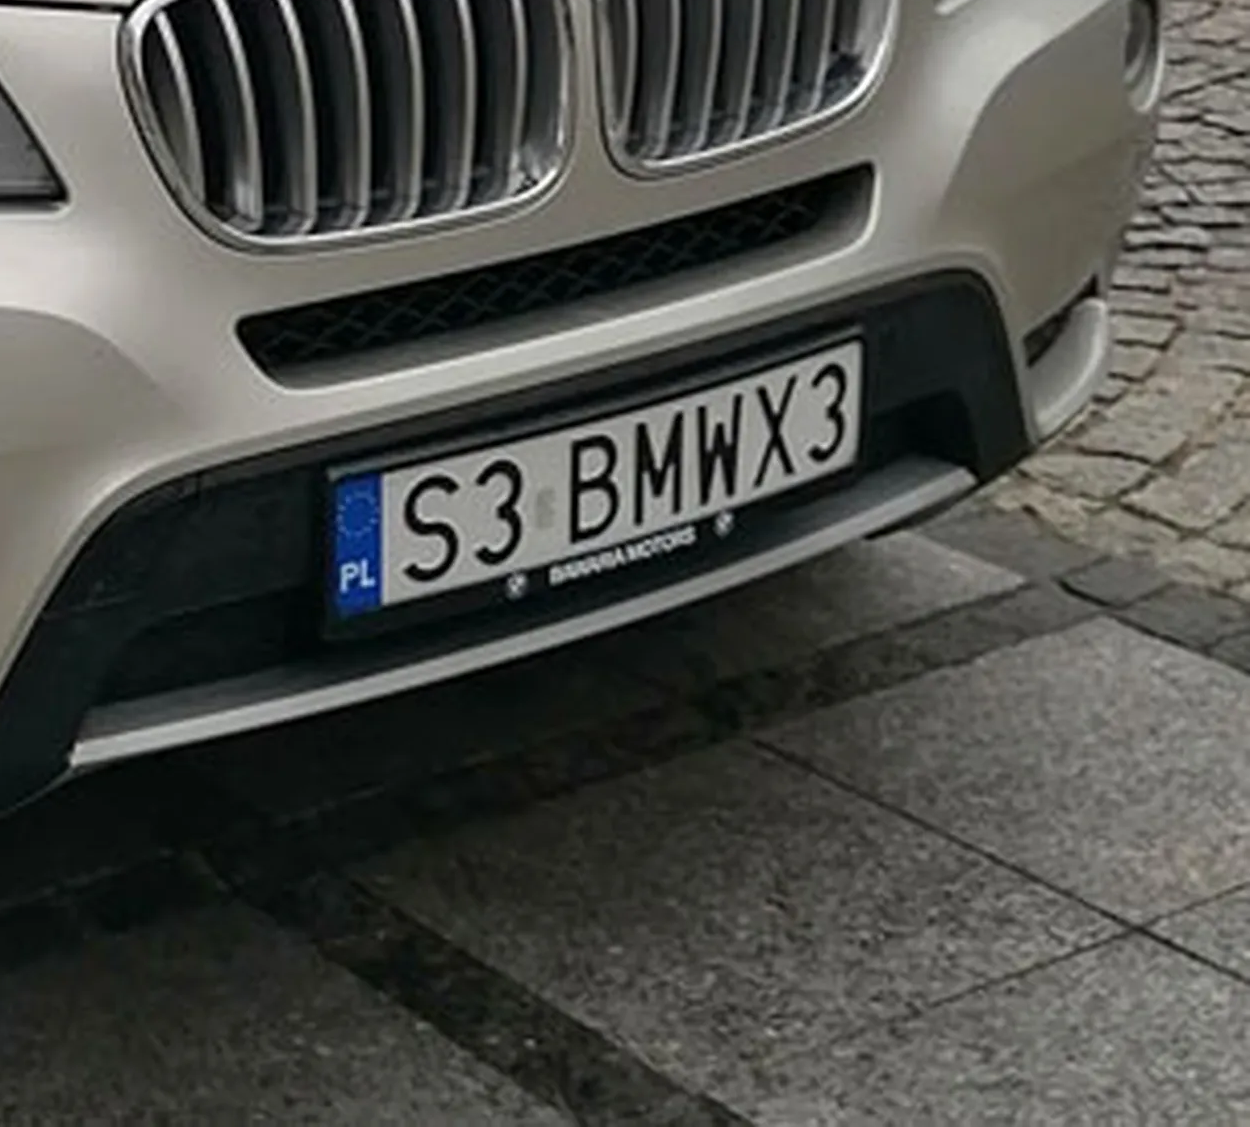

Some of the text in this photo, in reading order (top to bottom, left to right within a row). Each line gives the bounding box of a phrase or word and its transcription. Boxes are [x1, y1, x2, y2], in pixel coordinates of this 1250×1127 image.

[402, 362, 848, 583] S3 BMWX3
[340, 560, 376, 594] PL
